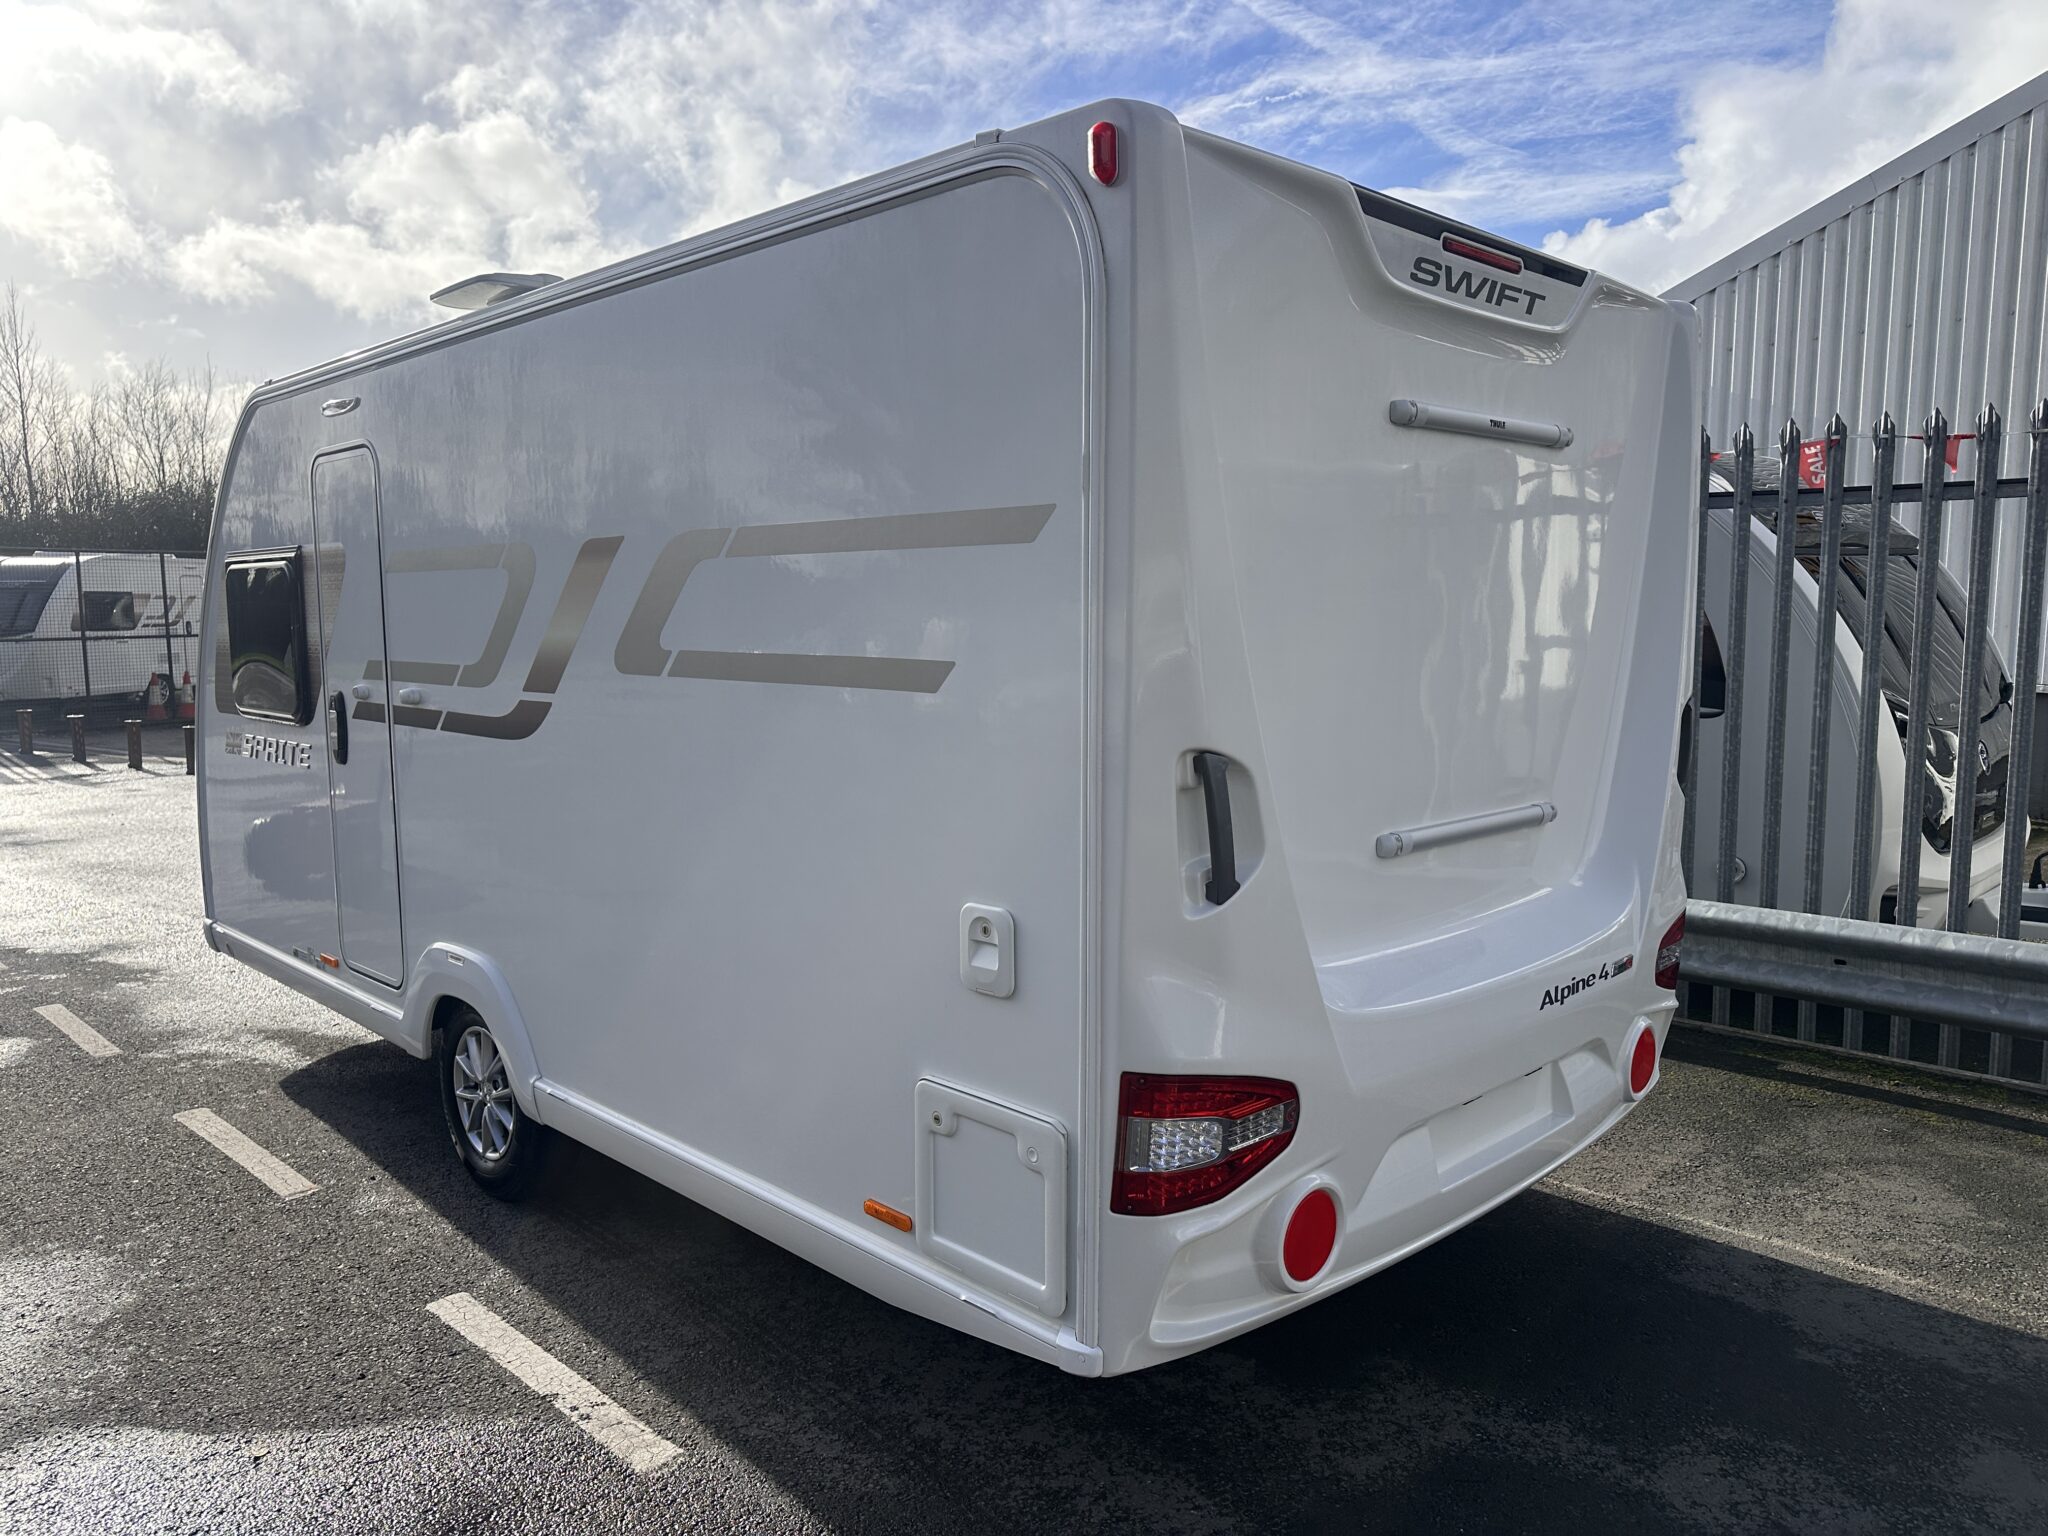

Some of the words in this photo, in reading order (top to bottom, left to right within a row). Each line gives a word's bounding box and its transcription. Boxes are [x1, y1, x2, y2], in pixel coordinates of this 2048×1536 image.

[1410, 257, 1546, 315] SWIFT
[1489, 418, 1506, 429] THULE
[1804, 445, 1825, 485] SALE
[242, 733, 312, 769] SPRITE
[1539, 973, 1596, 1011] Alpine
[1599, 962, 1609, 980] 4
